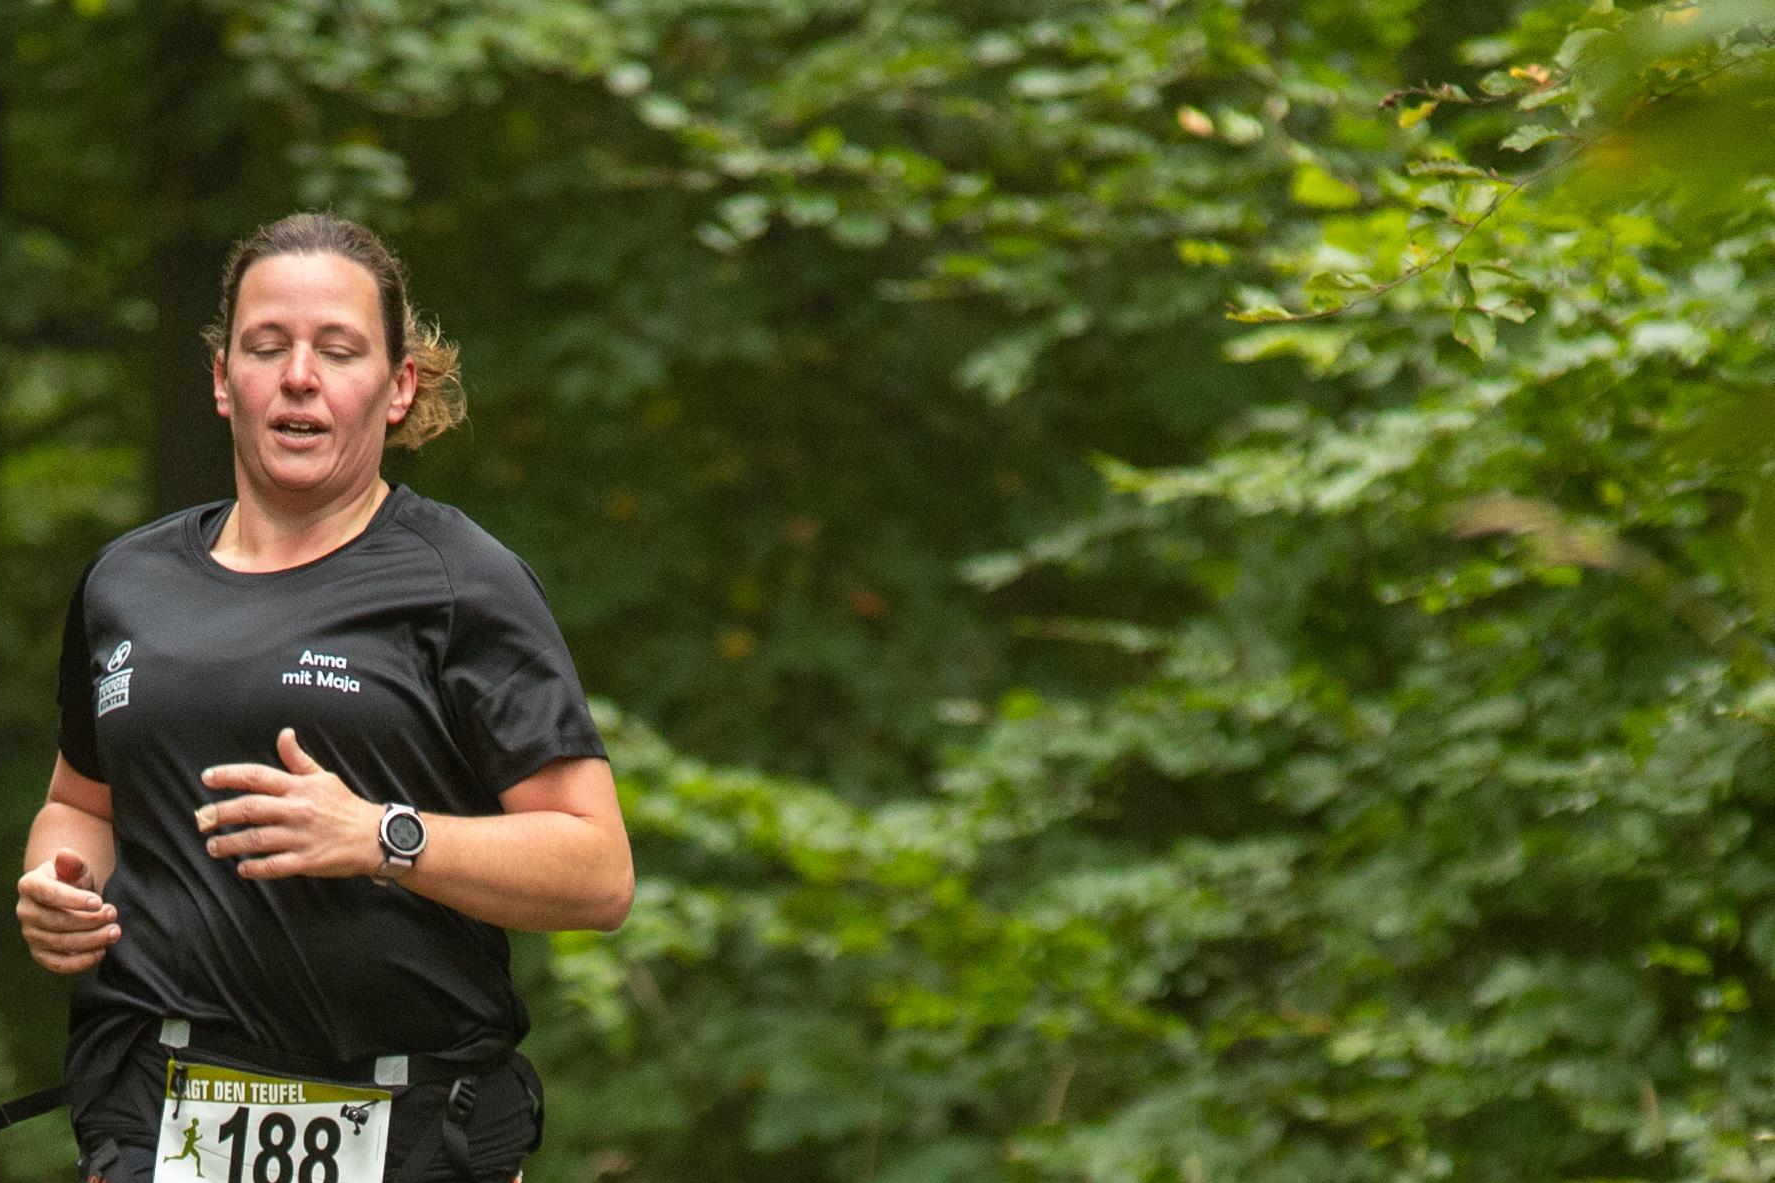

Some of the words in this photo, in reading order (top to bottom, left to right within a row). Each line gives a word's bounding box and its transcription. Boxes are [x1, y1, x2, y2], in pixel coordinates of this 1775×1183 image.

[299, 650, 347, 670] Anna
[282, 670, 313, 686] mit
[316, 670, 361, 693] Maja
[214, 1080, 245, 1102] DEN
[250, 1082, 307, 1104] TEUFEL
